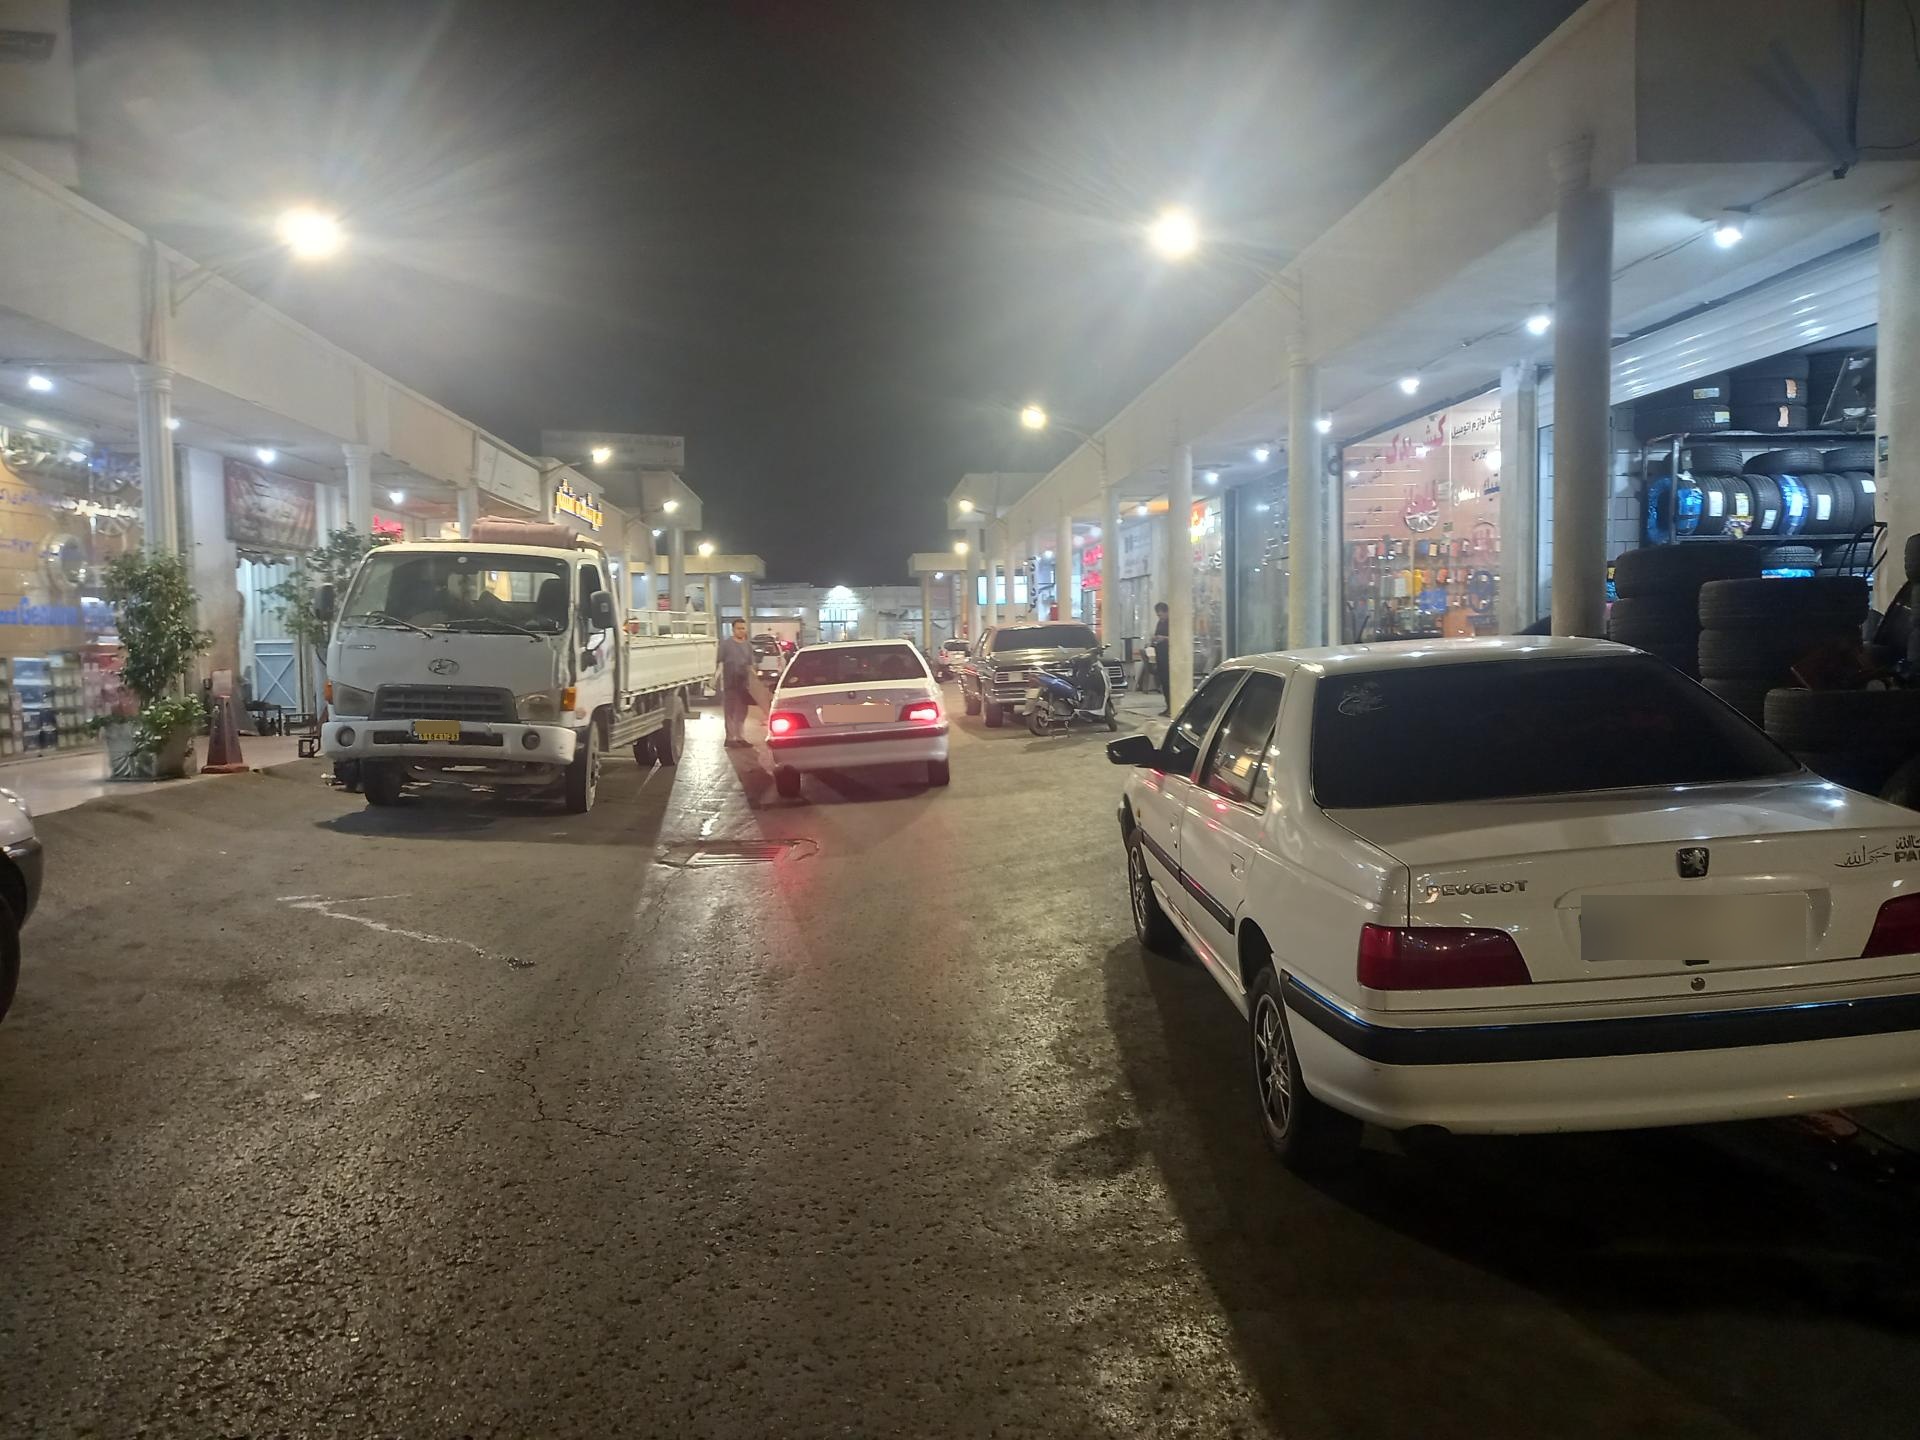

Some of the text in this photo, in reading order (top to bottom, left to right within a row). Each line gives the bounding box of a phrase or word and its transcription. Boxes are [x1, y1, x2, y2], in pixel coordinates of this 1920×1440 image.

[1471, 415, 1487, 432] لوازم
[1894, 850, 1920, 864] PA
[1426, 880, 1528, 898] PEUGEOT
